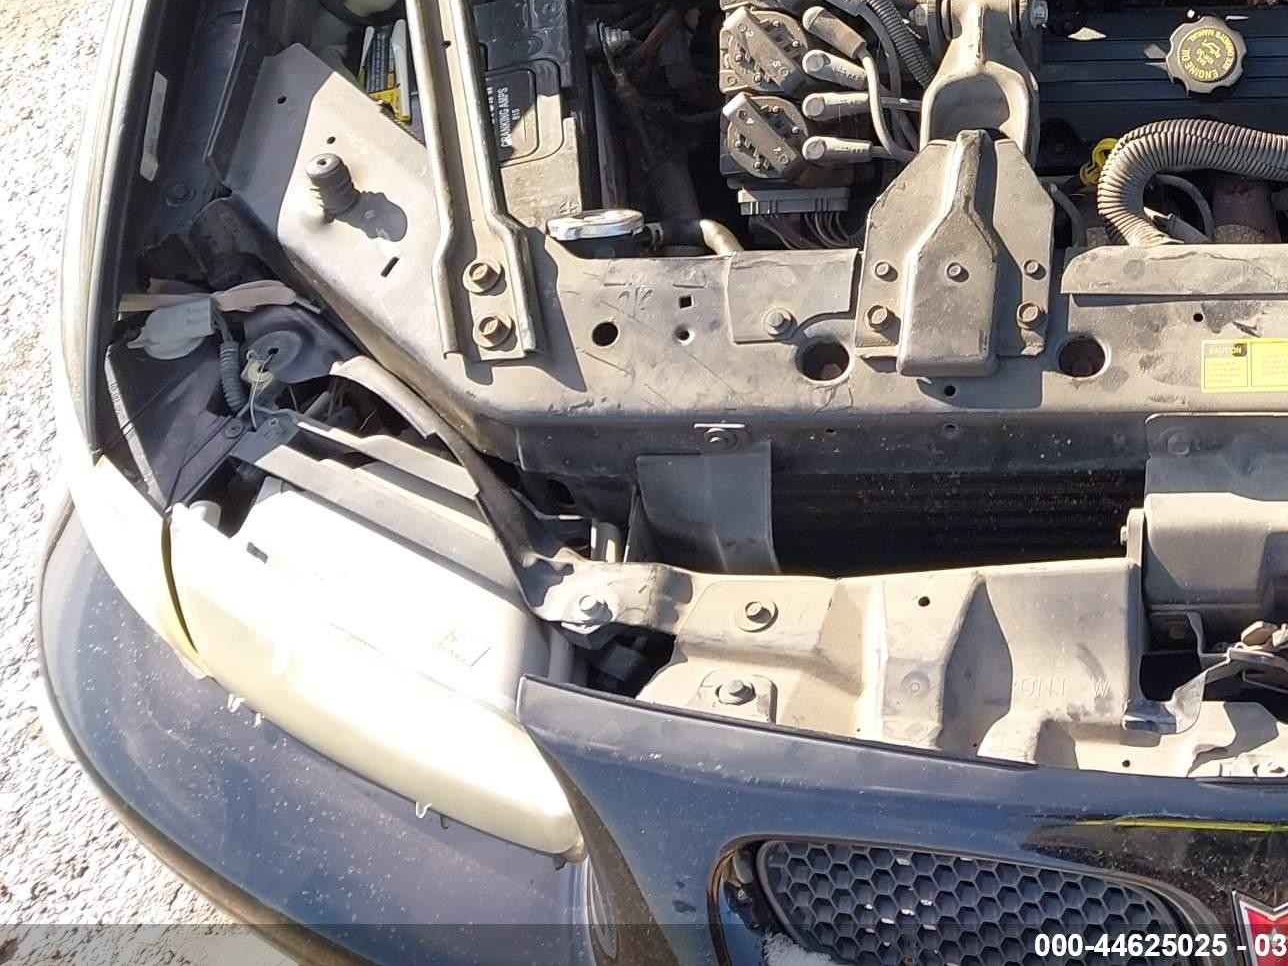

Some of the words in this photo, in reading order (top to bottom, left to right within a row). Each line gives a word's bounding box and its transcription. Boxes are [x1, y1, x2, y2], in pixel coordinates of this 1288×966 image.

[1181, 48, 1191, 61] OIL
[1184, 61, 1218, 79] ENGINE
[497, 87, 508, 108] AMPS
[500, 108, 512, 148] CRANKING
